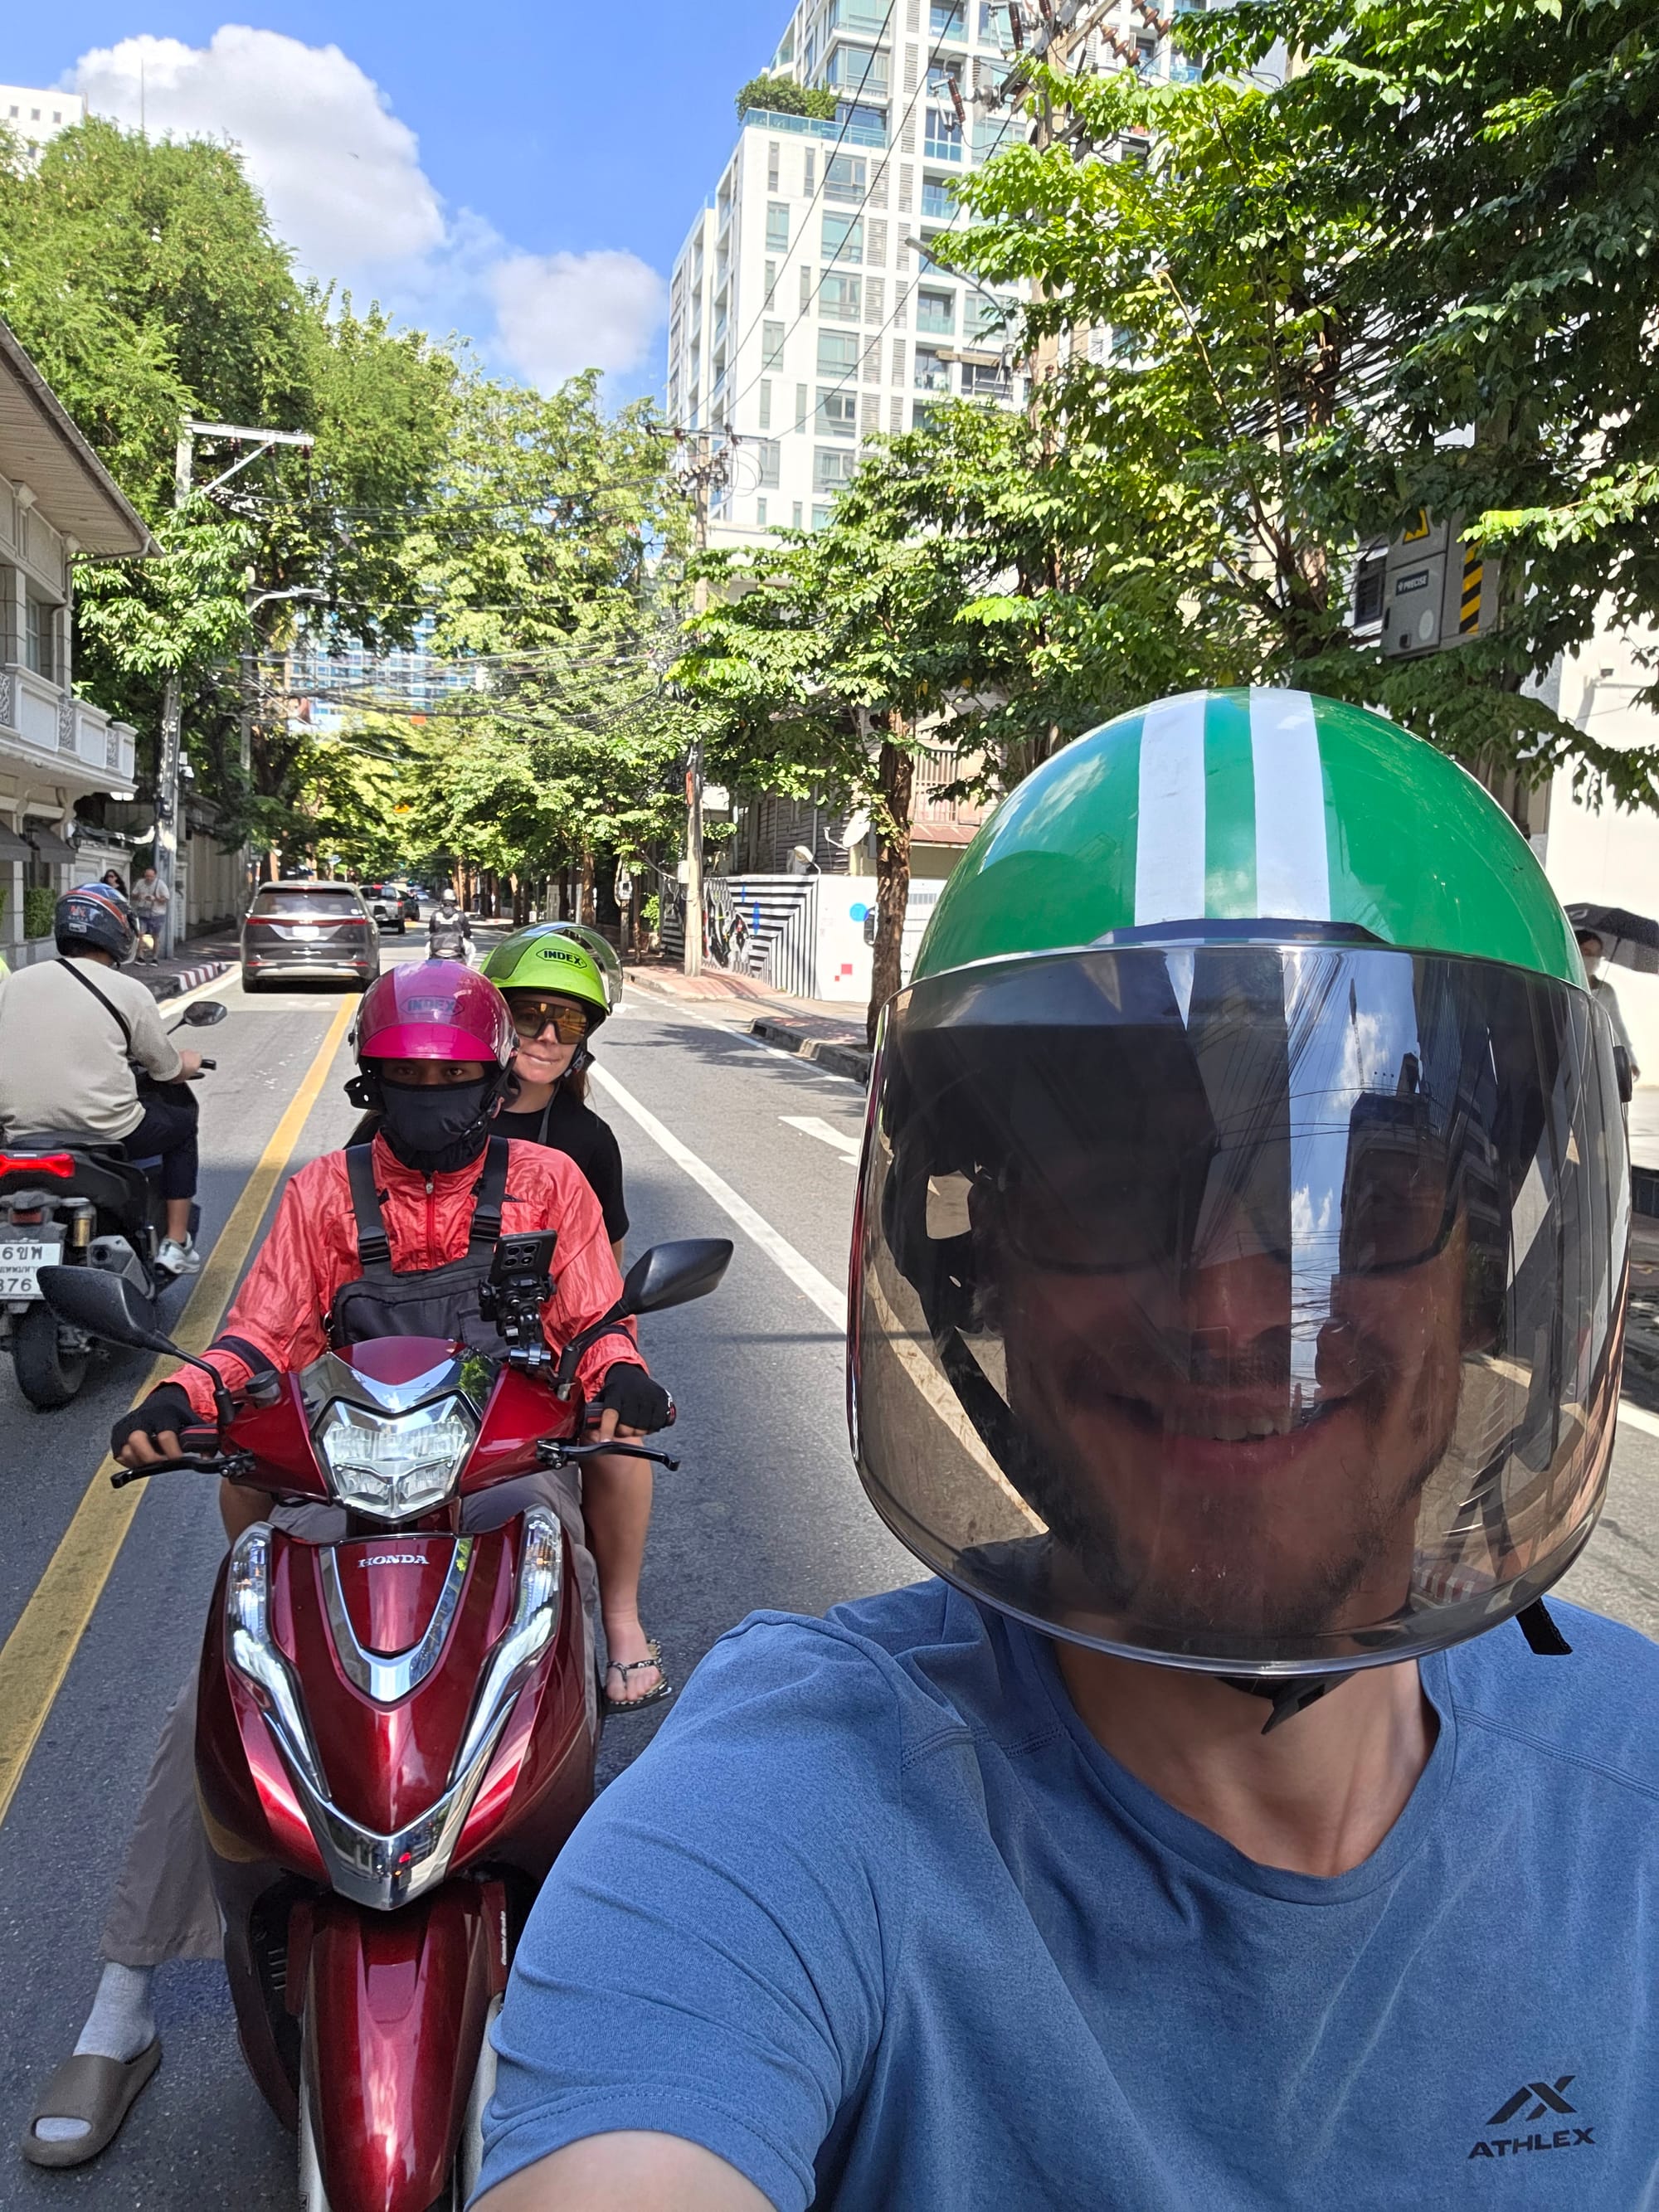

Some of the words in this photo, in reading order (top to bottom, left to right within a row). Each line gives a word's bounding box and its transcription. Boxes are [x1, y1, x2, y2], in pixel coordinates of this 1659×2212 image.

[1404, 575, 1427, 591] PRECISE
[544, 950, 581, 965] INDEX
[407, 999, 455, 1013] INDEX
[358, 1554, 430, 1568] HONDA
[1468, 2127, 1596, 2159] ATHLEX
